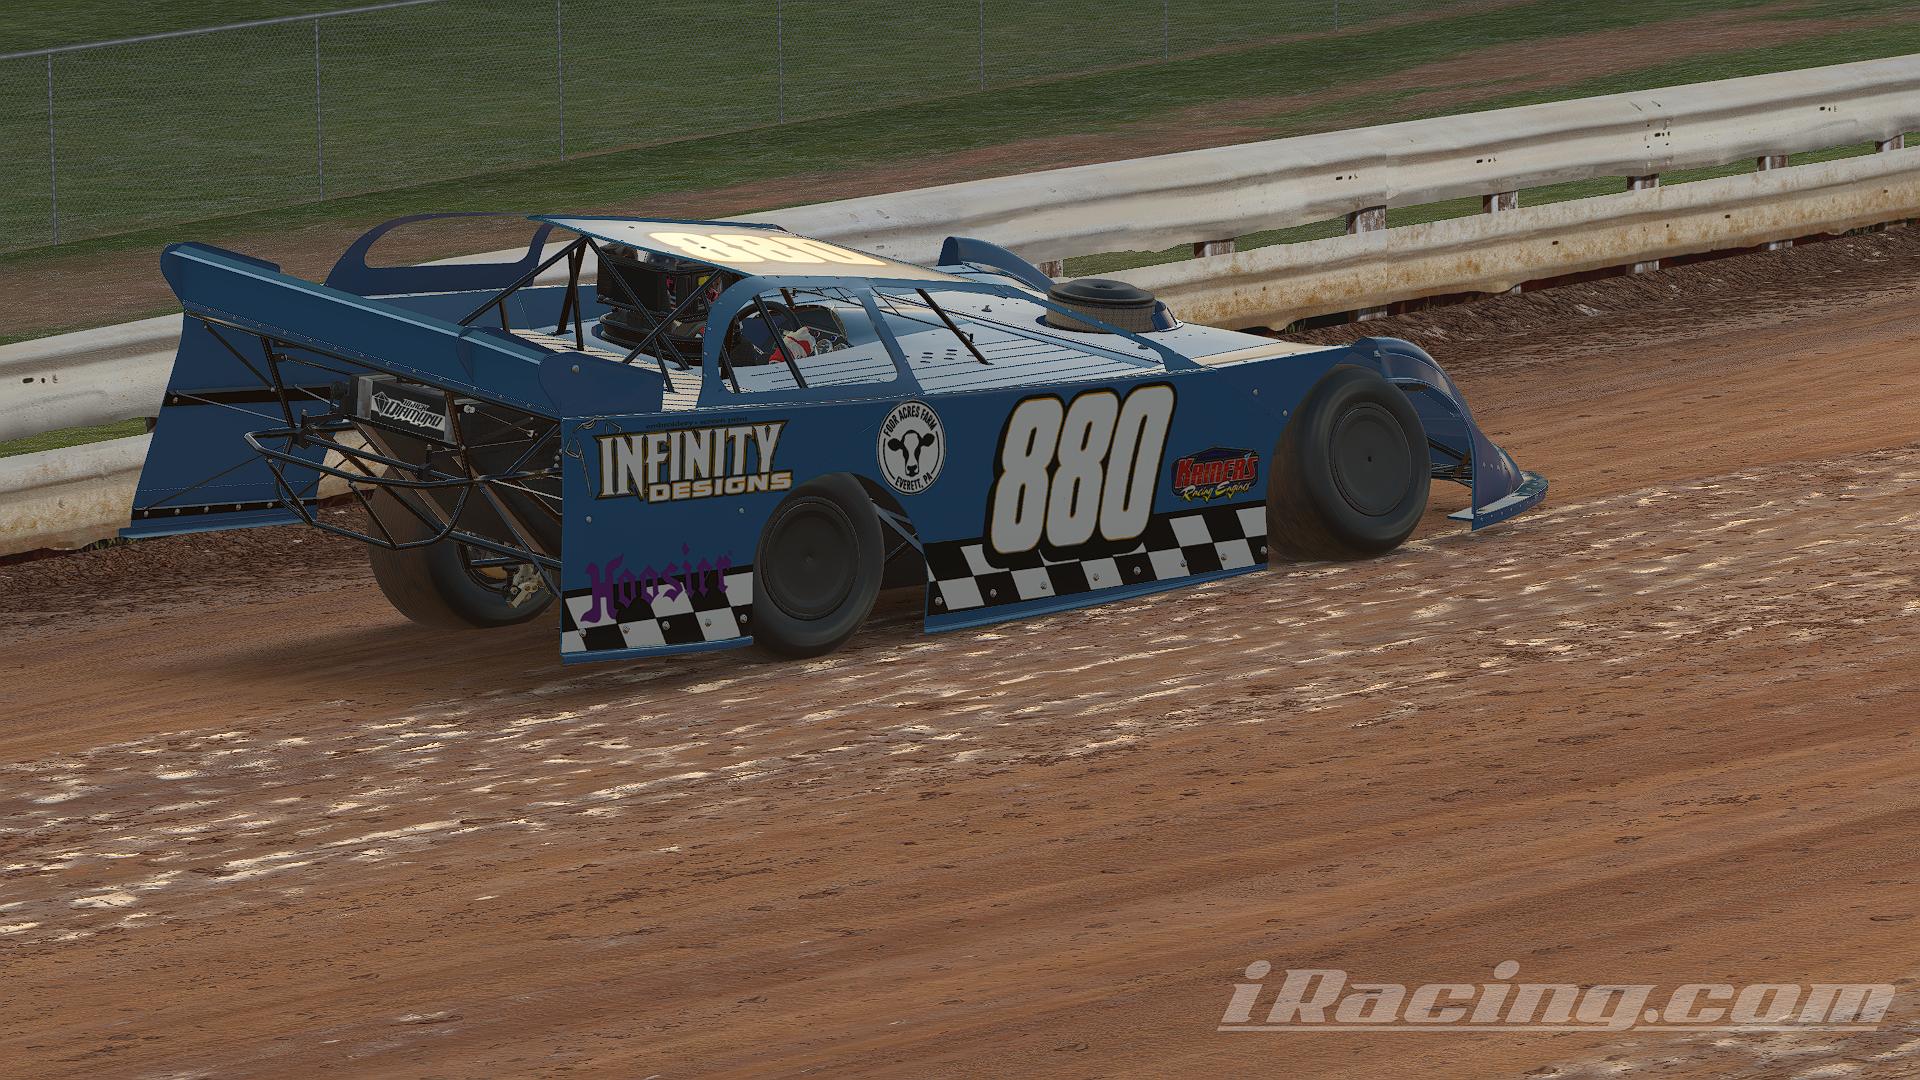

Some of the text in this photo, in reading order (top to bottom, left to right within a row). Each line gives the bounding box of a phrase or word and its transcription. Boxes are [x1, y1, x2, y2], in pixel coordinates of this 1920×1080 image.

[650, 232, 887, 265] 880
[898, 405, 920, 421] ACRES
[920, 408, 937, 431] FARM
[596, 421, 788, 500] INFINITY
[987, 384, 1176, 556] 880
[649, 471, 793, 503] DESIGNS
[923, 472, 933, 484] PA
[1180, 485, 1214, 502] Racing
[580, 543, 735, 623] Hoosier
